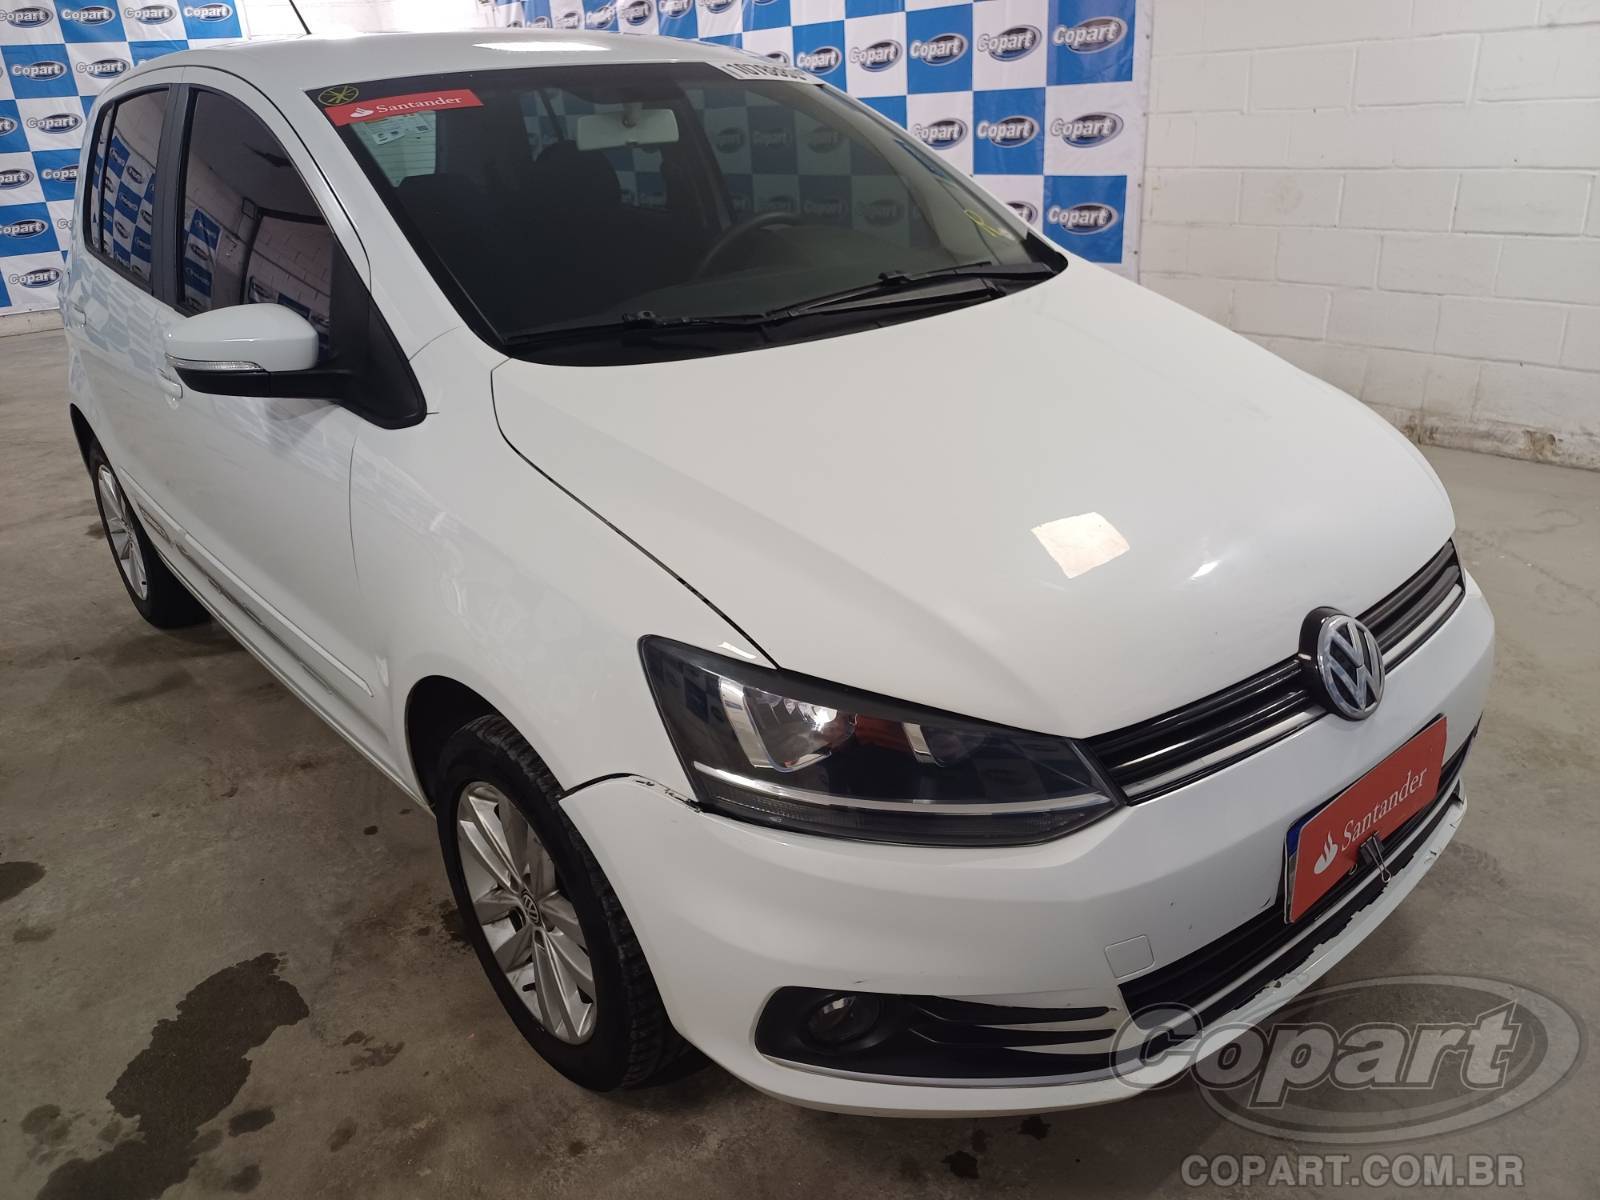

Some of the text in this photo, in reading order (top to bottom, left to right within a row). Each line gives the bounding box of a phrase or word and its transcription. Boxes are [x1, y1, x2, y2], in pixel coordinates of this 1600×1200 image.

[0, 9, 45, 22] Copart
[62, 9, 109, 21] Copart
[124, 7, 169, 19] Copart
[183, 5, 227, 18] Copart
[1053, 21, 1116, 48] Copart
[910, 39, 960, 62] Copart
[978, 32, 1032, 55] Copart
[797, 51, 836, 70] Copart
[851, 46, 896, 68] Copart
[12, 62, 61, 77] Copart
[77, 60, 123, 75] Copart
[375, 97, 463, 113] Santander
[27, 115, 76, 130] Copart
[1051, 117, 1111, 140] Copart
[911, 121, 961, 143] Copart
[977, 121, 1029, 143] Copart
[41, 168, 78, 181] Copa
[1048, 204, 1110, 229] Copart
[0, 222, 41, 238] opart
[9, 271, 57, 286] Copart
[1341, 767, 1428, 852] Santander
